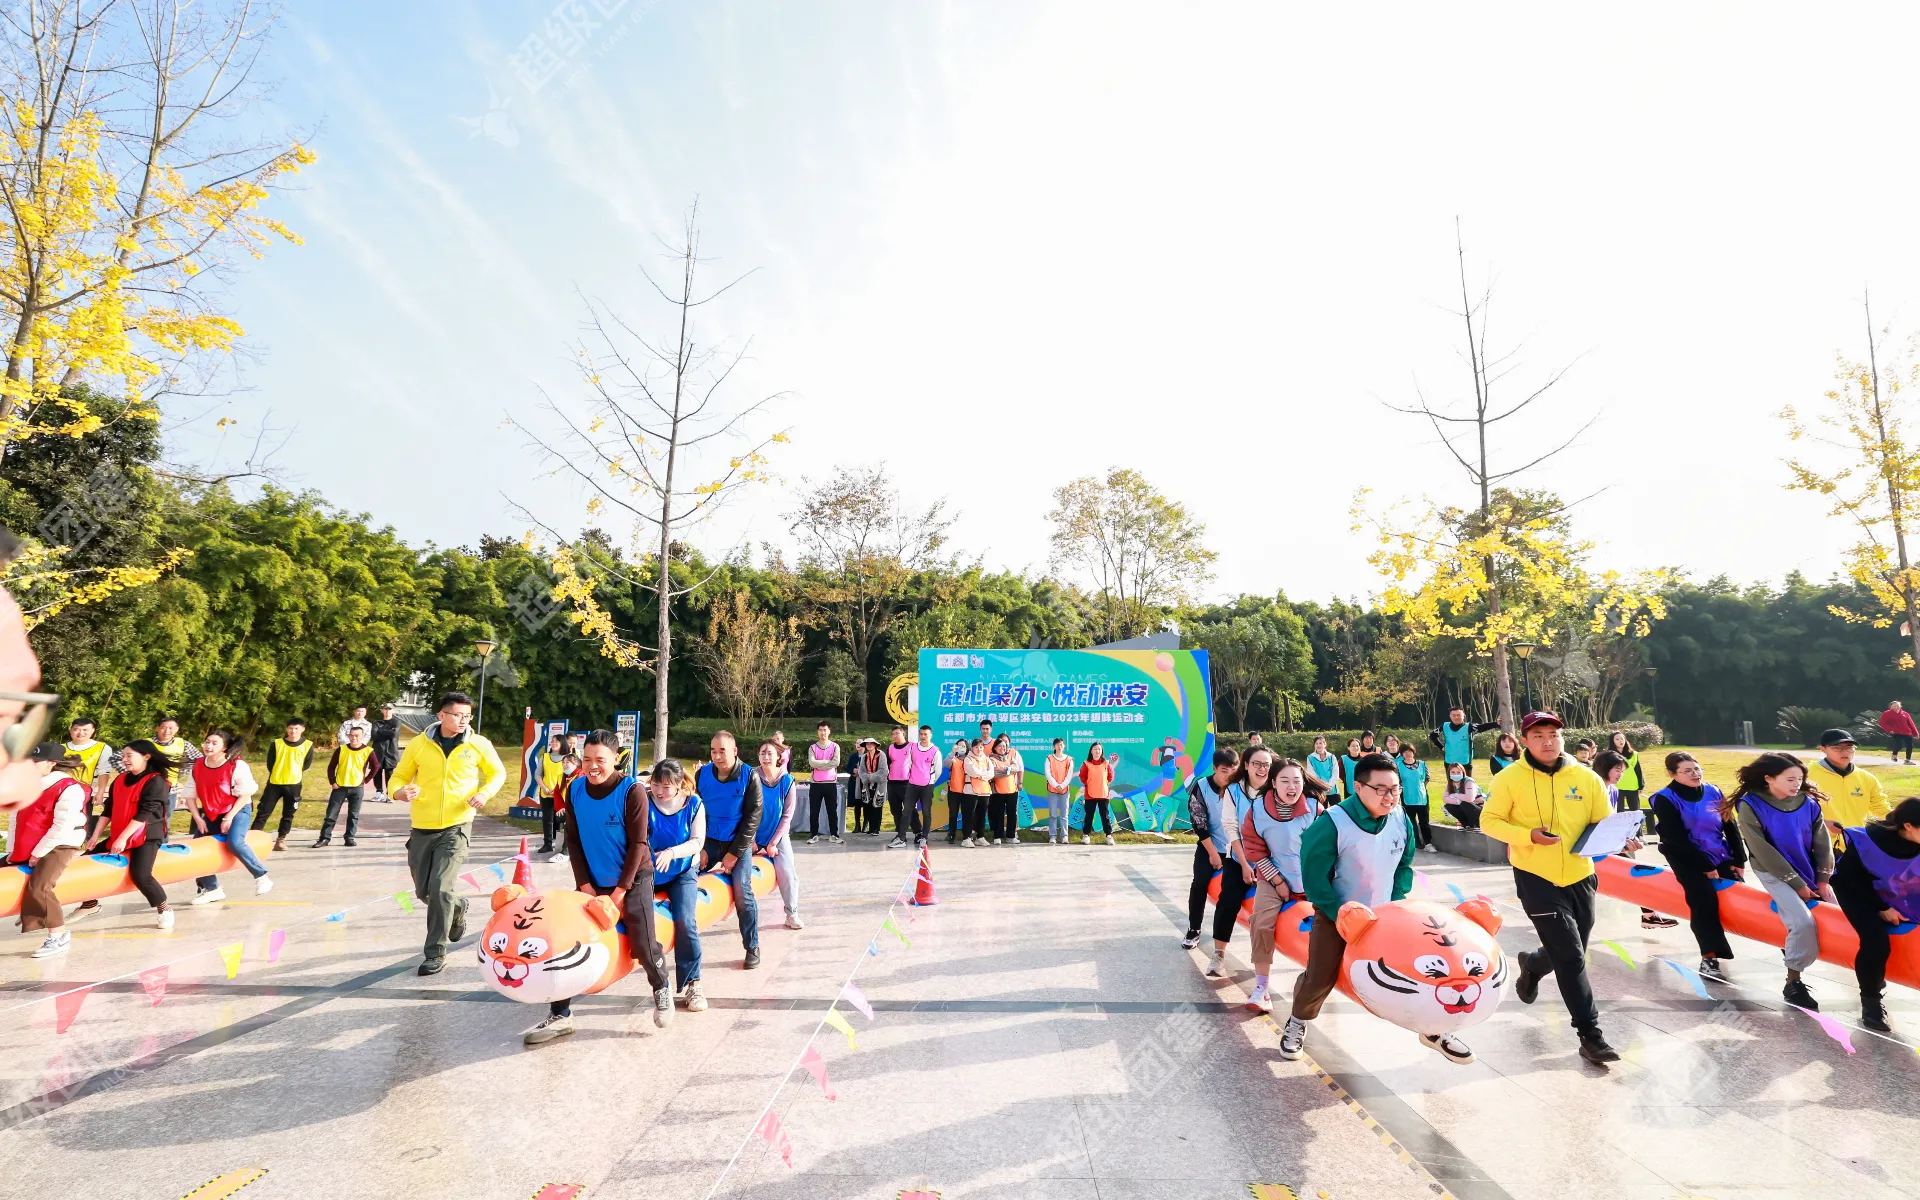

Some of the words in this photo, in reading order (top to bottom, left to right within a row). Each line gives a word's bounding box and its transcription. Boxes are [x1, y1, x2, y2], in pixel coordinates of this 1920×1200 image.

[938, 681, 1149, 707] 凝心聚力·悦动洪安
